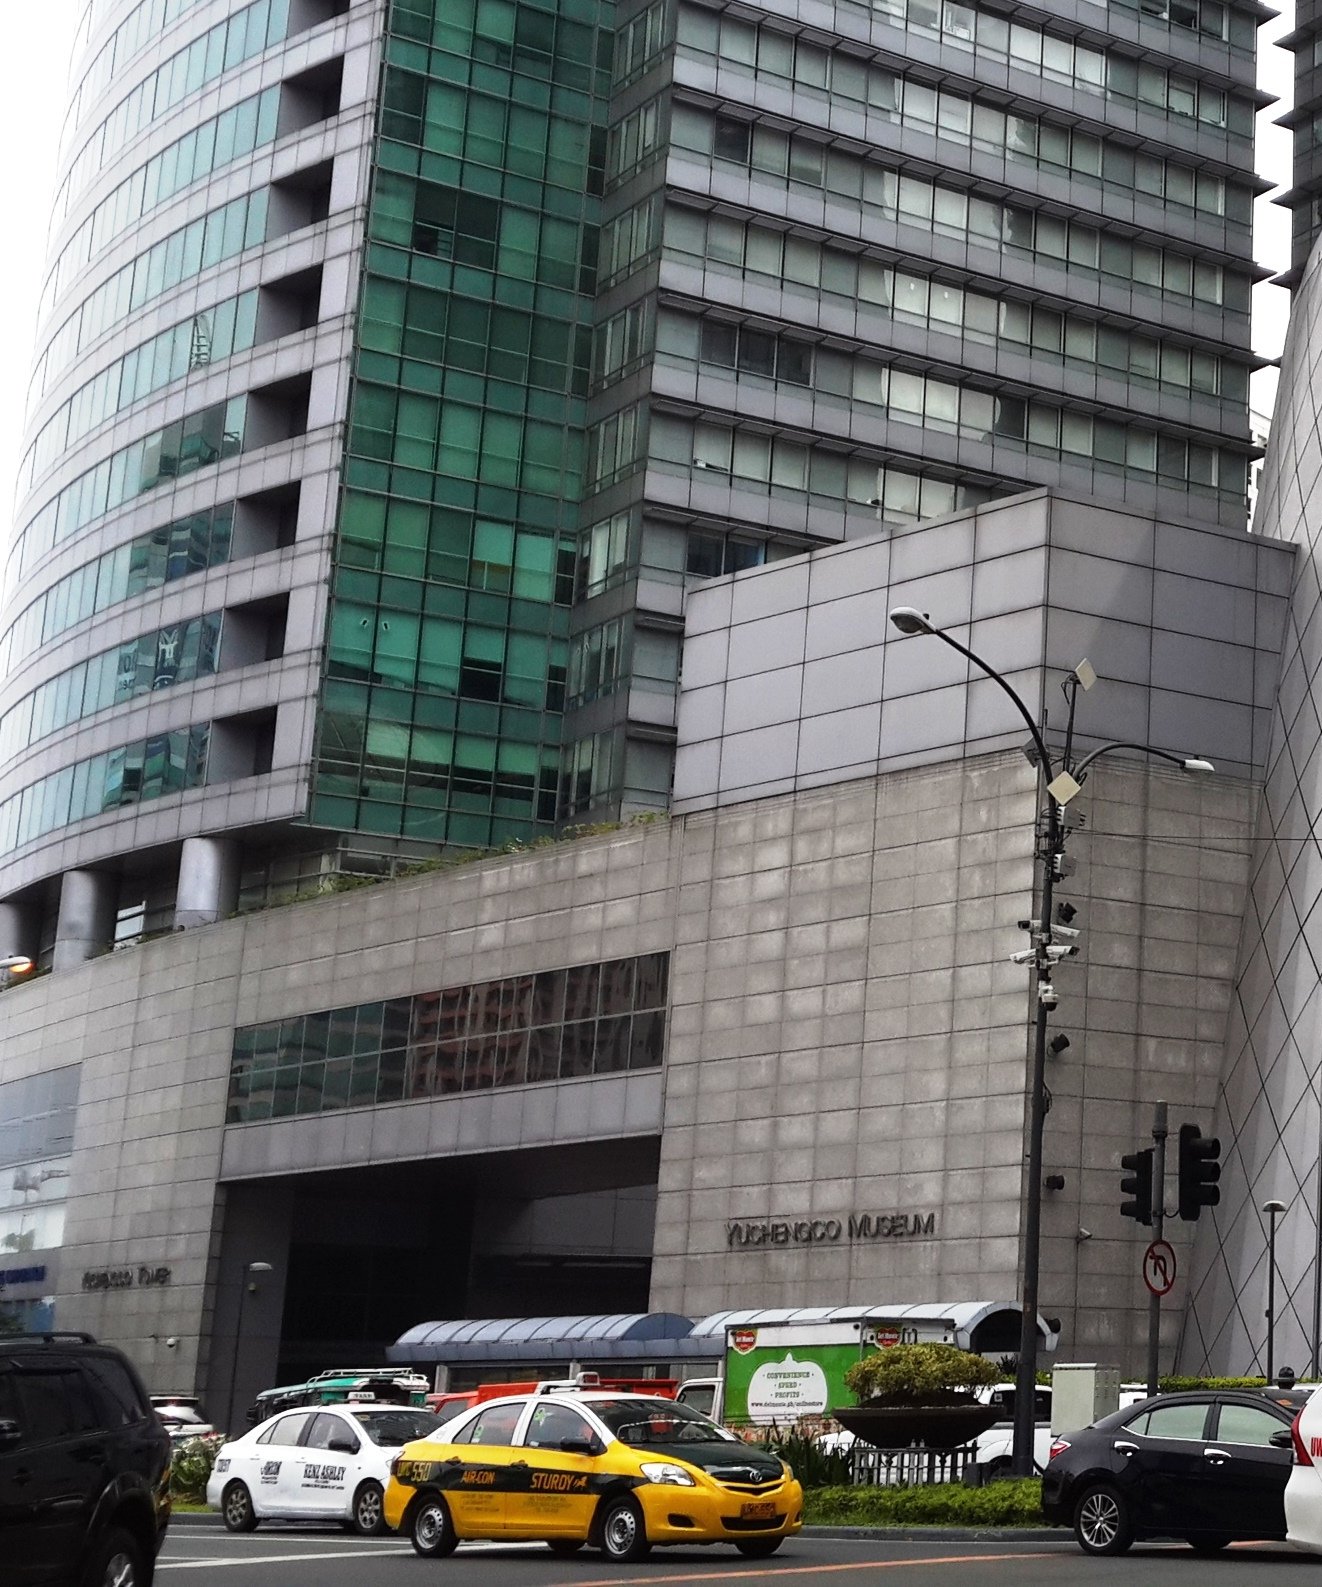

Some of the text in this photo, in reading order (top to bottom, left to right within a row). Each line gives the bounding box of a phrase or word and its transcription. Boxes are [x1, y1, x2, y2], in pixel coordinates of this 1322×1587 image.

[727, 1213, 935, 1246] YUCHENGCO MUSEUM
[774, 1391, 800, 1399] PROFITS
[411, 1461, 432, 1482] 550
[530, 1472, 574, 1491] STURDY
